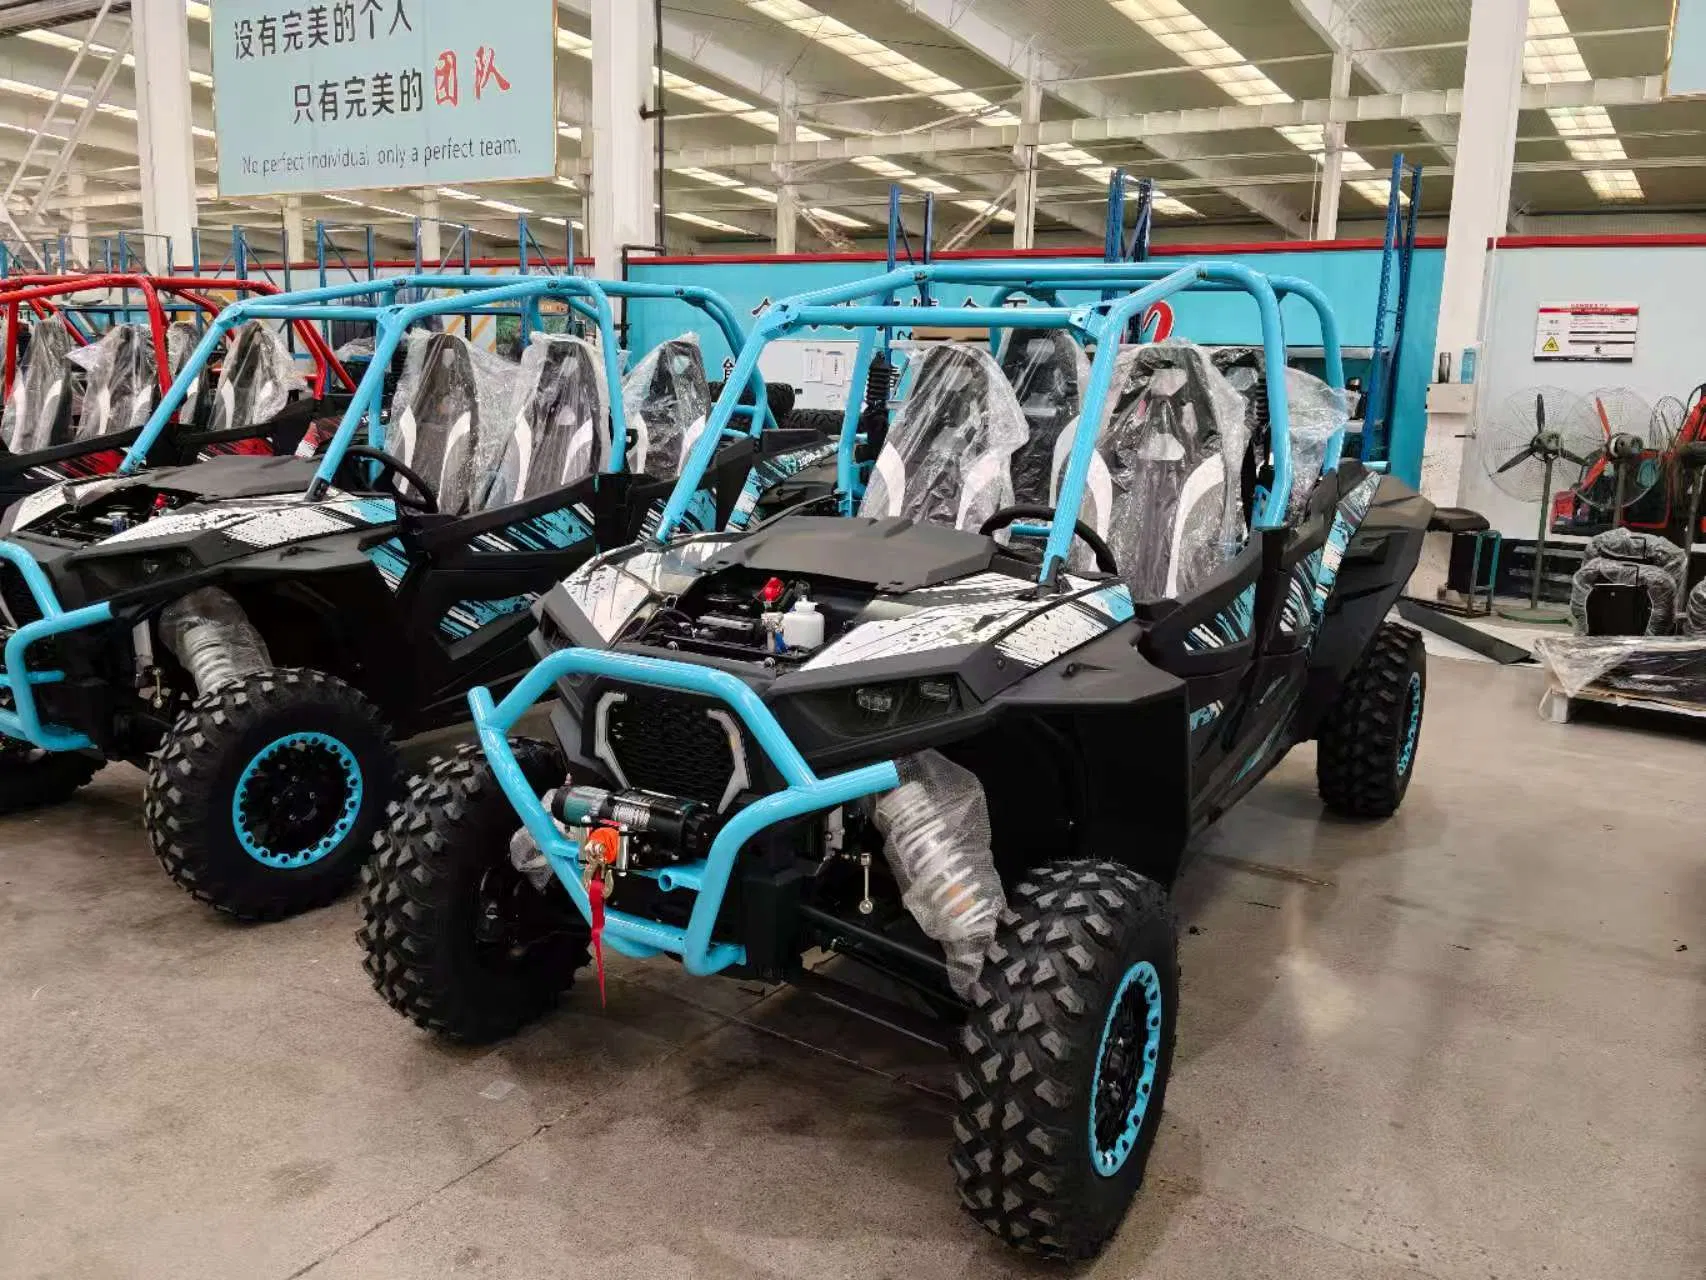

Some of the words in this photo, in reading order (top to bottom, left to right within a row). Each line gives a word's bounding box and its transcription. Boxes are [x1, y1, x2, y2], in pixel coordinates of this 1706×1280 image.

[234, 0, 412, 59] 没有完美的个人
[242, 155, 258, 174] No
[263, 152, 304, 177] perfect
[377, 144, 406, 168] only
[411, 147, 419, 162] a
[424, 137, 475, 167] perfect
[480, 136, 521, 157] team.
